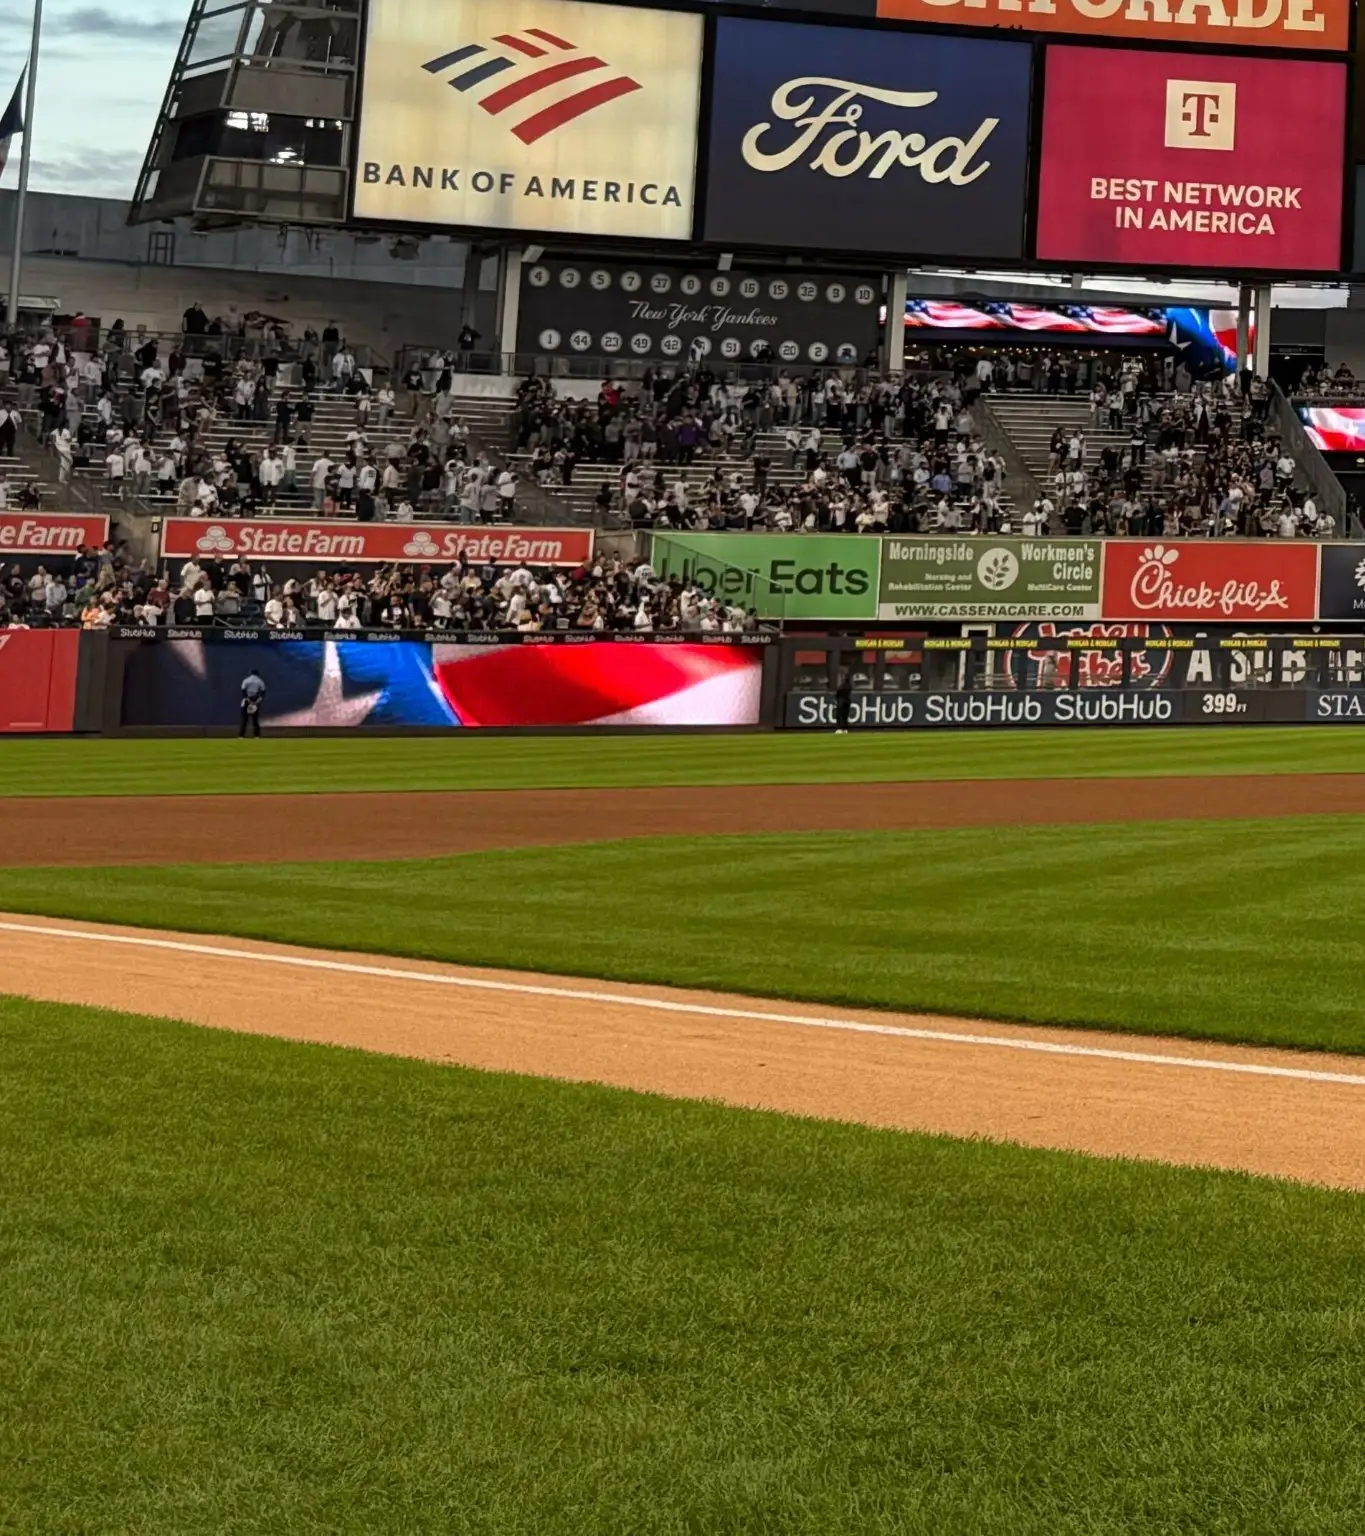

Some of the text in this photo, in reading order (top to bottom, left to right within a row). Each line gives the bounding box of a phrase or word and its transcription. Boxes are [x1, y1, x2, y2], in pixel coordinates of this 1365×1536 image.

[741, 76, 1000, 187] Ford
[363, 161, 682, 207] BANK OF AMERICA
[1090, 177, 1302, 210] BEST NETWORK
[1114, 205, 1276, 236] IN AMERICA
[629, 300, 778, 332] New York Yankees
[889, 542, 974, 565] Morningside
[1021, 543, 1095, 561] Workmen's
[769, 559, 869, 595] Eats
[1052, 563, 1093, 580] Circle
[1131, 554, 1290, 616] Chick-fil-A
[895, 604, 1084, 617] WWW.CASSENACARE.COM
[925, 694, 1042, 723] StubHub
[1054, 692, 1172, 721] StubHub
